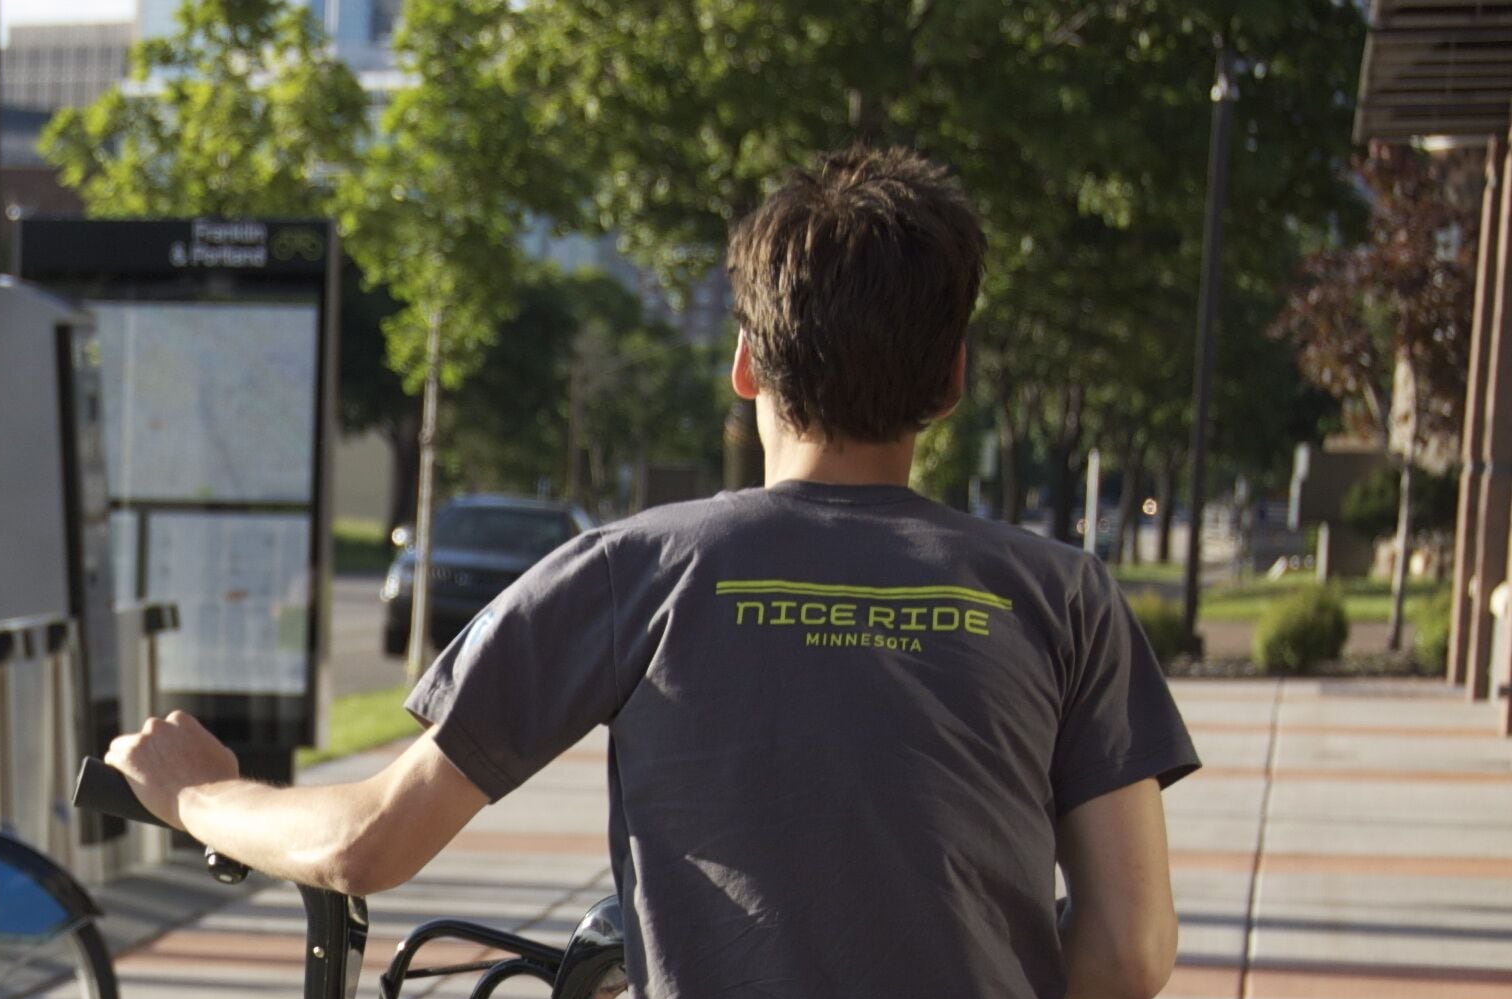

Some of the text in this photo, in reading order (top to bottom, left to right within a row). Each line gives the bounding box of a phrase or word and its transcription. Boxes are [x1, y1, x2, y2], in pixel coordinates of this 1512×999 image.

[191, 244, 268, 267] Portland
[736, 601, 990, 635] NICE RIDE
[805, 632, 923, 652] MINNESOTA
